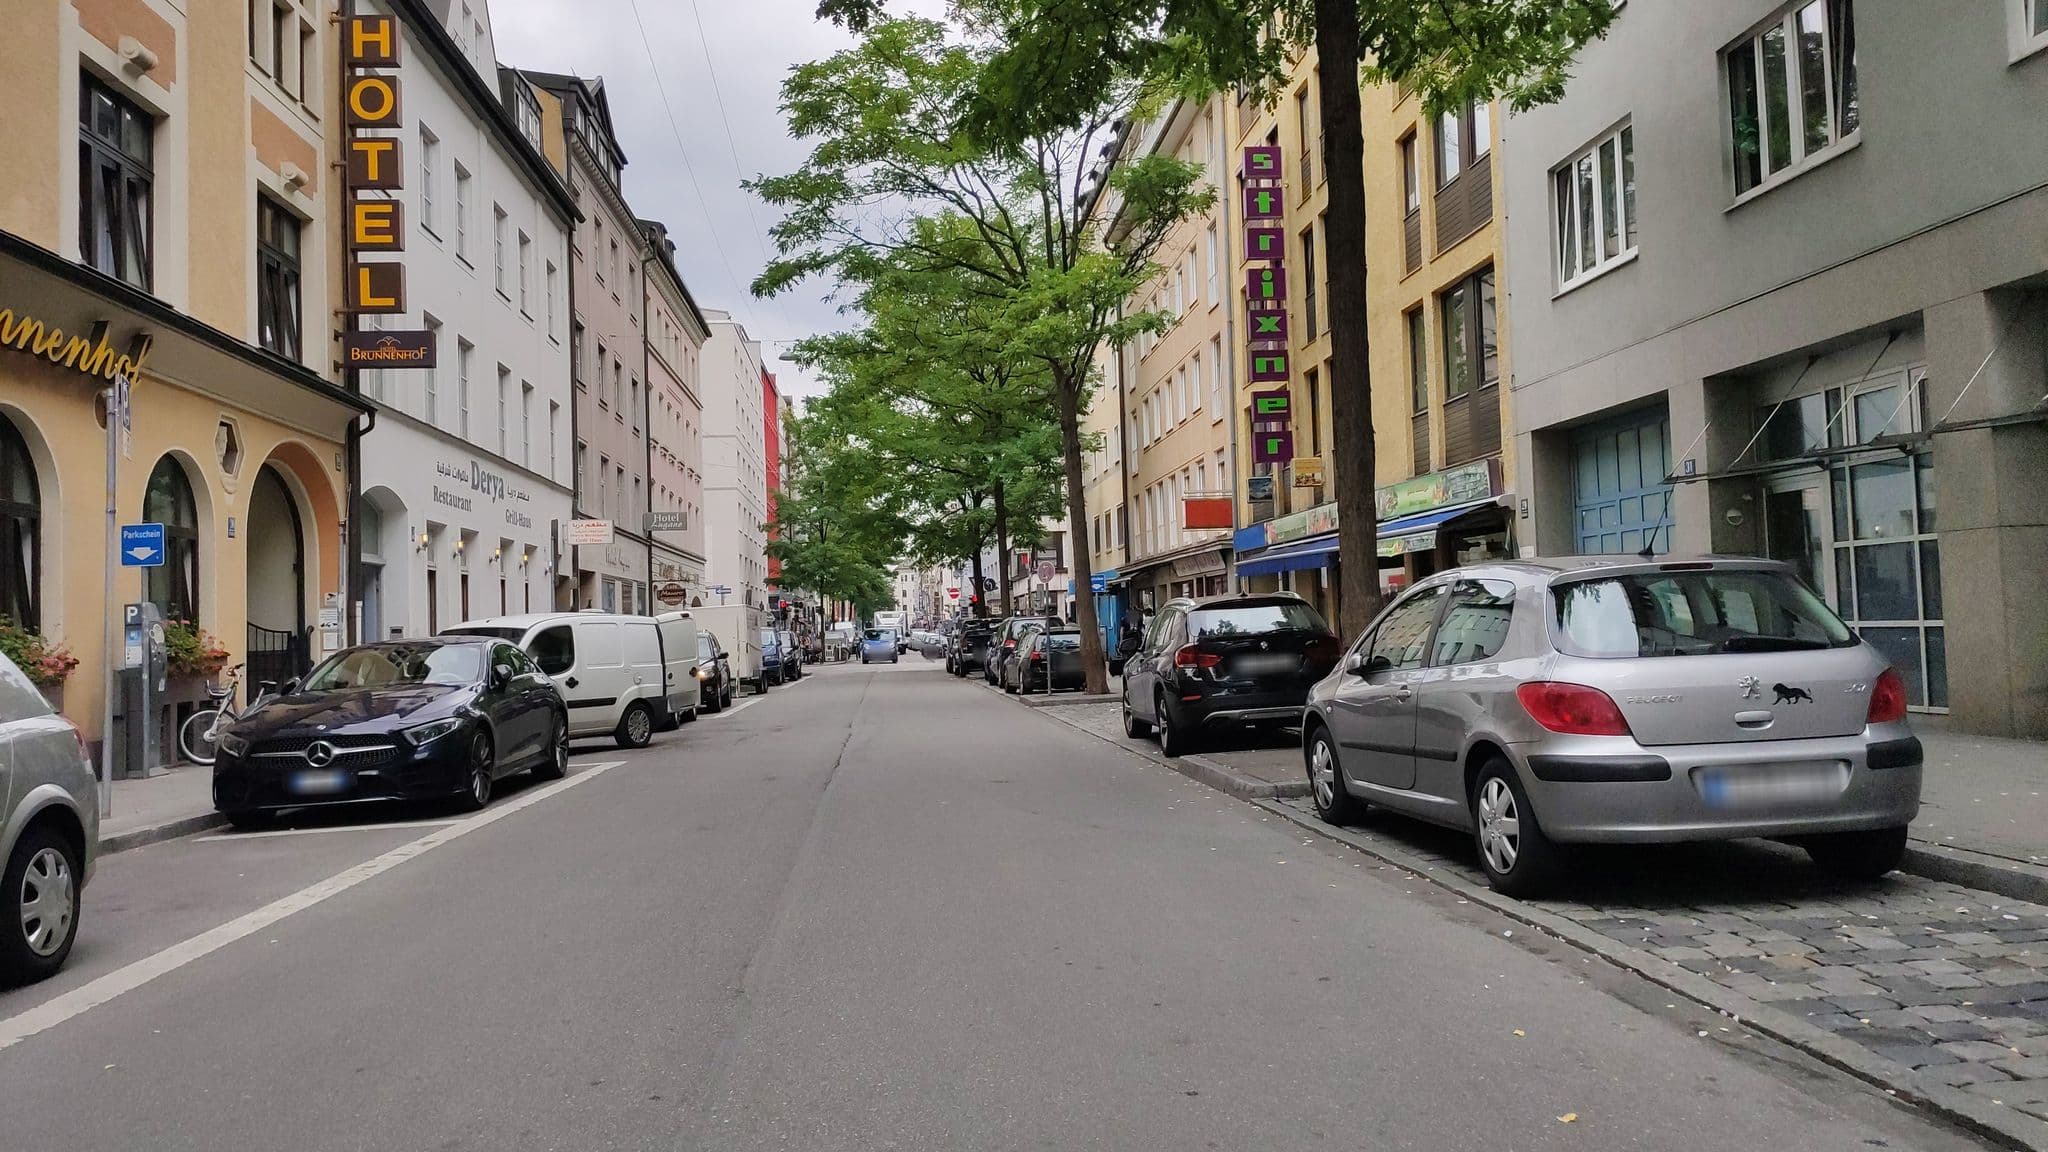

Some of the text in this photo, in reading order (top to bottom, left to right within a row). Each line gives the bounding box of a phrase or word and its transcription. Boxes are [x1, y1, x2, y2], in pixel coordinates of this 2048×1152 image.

[350, 19, 396, 307] HOTEL
[471, 460, 505, 504] Derya
[433, 485, 472, 512] Restaurant
[505, 509, 532, 528] Grill-Haus
[653, 513, 680, 522] Hotel
[123, 530, 161, 539] Parkschein
